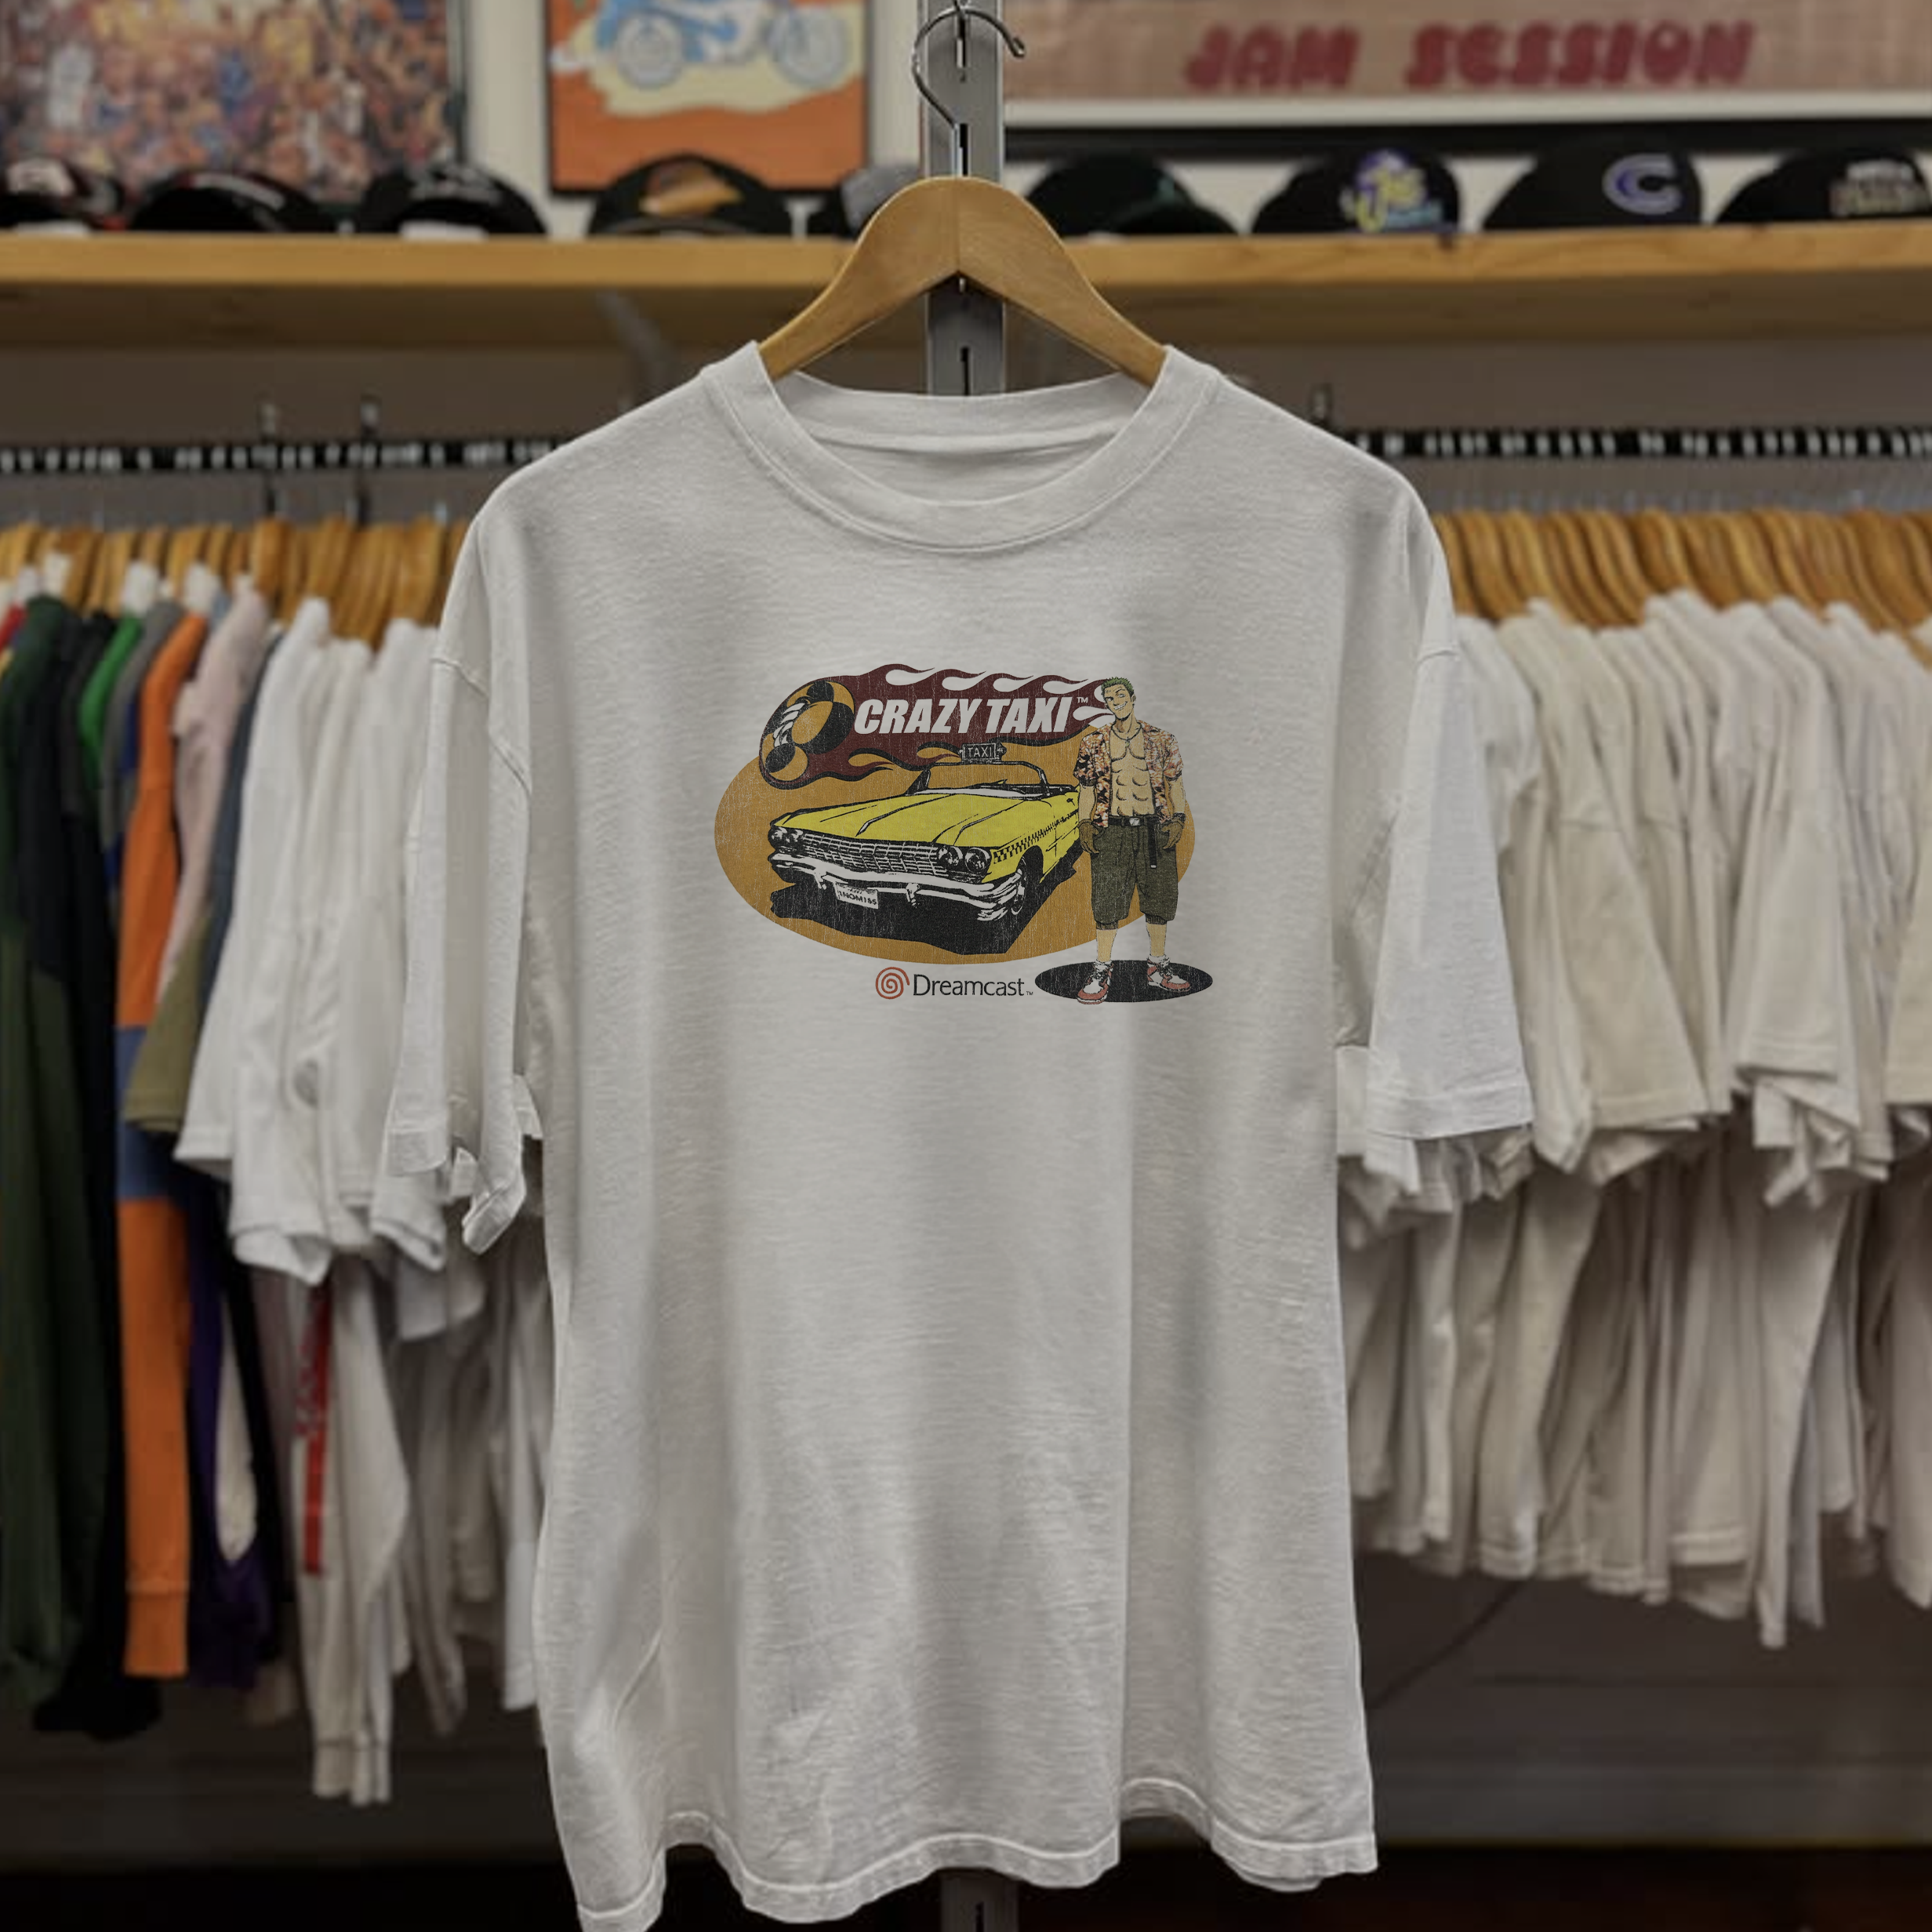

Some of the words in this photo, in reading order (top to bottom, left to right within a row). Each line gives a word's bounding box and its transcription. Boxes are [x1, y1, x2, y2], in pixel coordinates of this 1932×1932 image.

[1183, 24, 1361, 88] JAM
[1404, 20, 1754, 86] SESSION
[854, 699, 982, 735] CRAZY
[985, 696, 1073, 734] TAXI
[968, 746, 993, 758] TAXI
[913, 974, 1025, 996] Dreamcast
